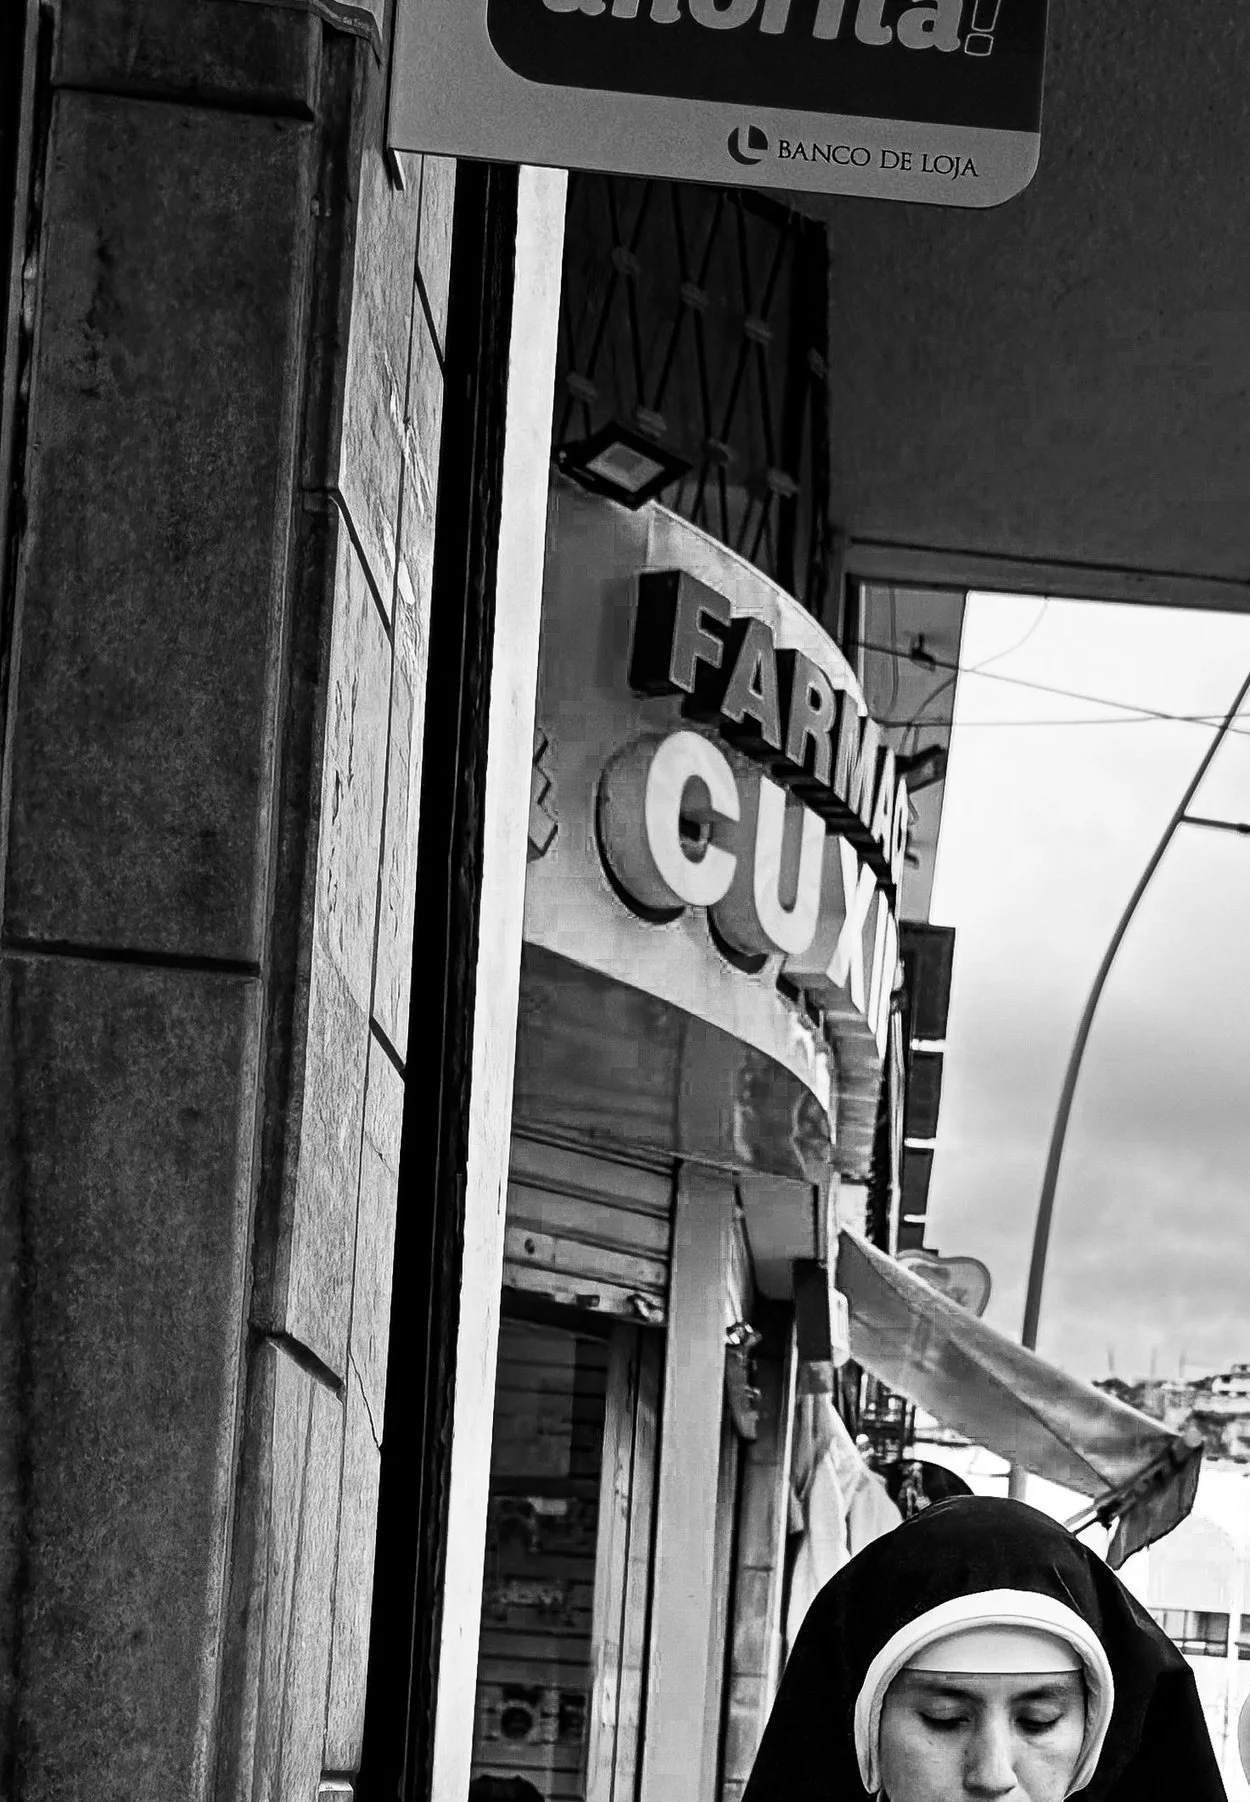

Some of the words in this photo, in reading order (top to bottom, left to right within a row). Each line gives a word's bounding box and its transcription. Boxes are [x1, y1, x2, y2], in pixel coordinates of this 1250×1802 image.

[777, 138, 871, 168] BANCO
[879, 149, 913, 172] DE
[921, 152, 979, 181] LOJA
